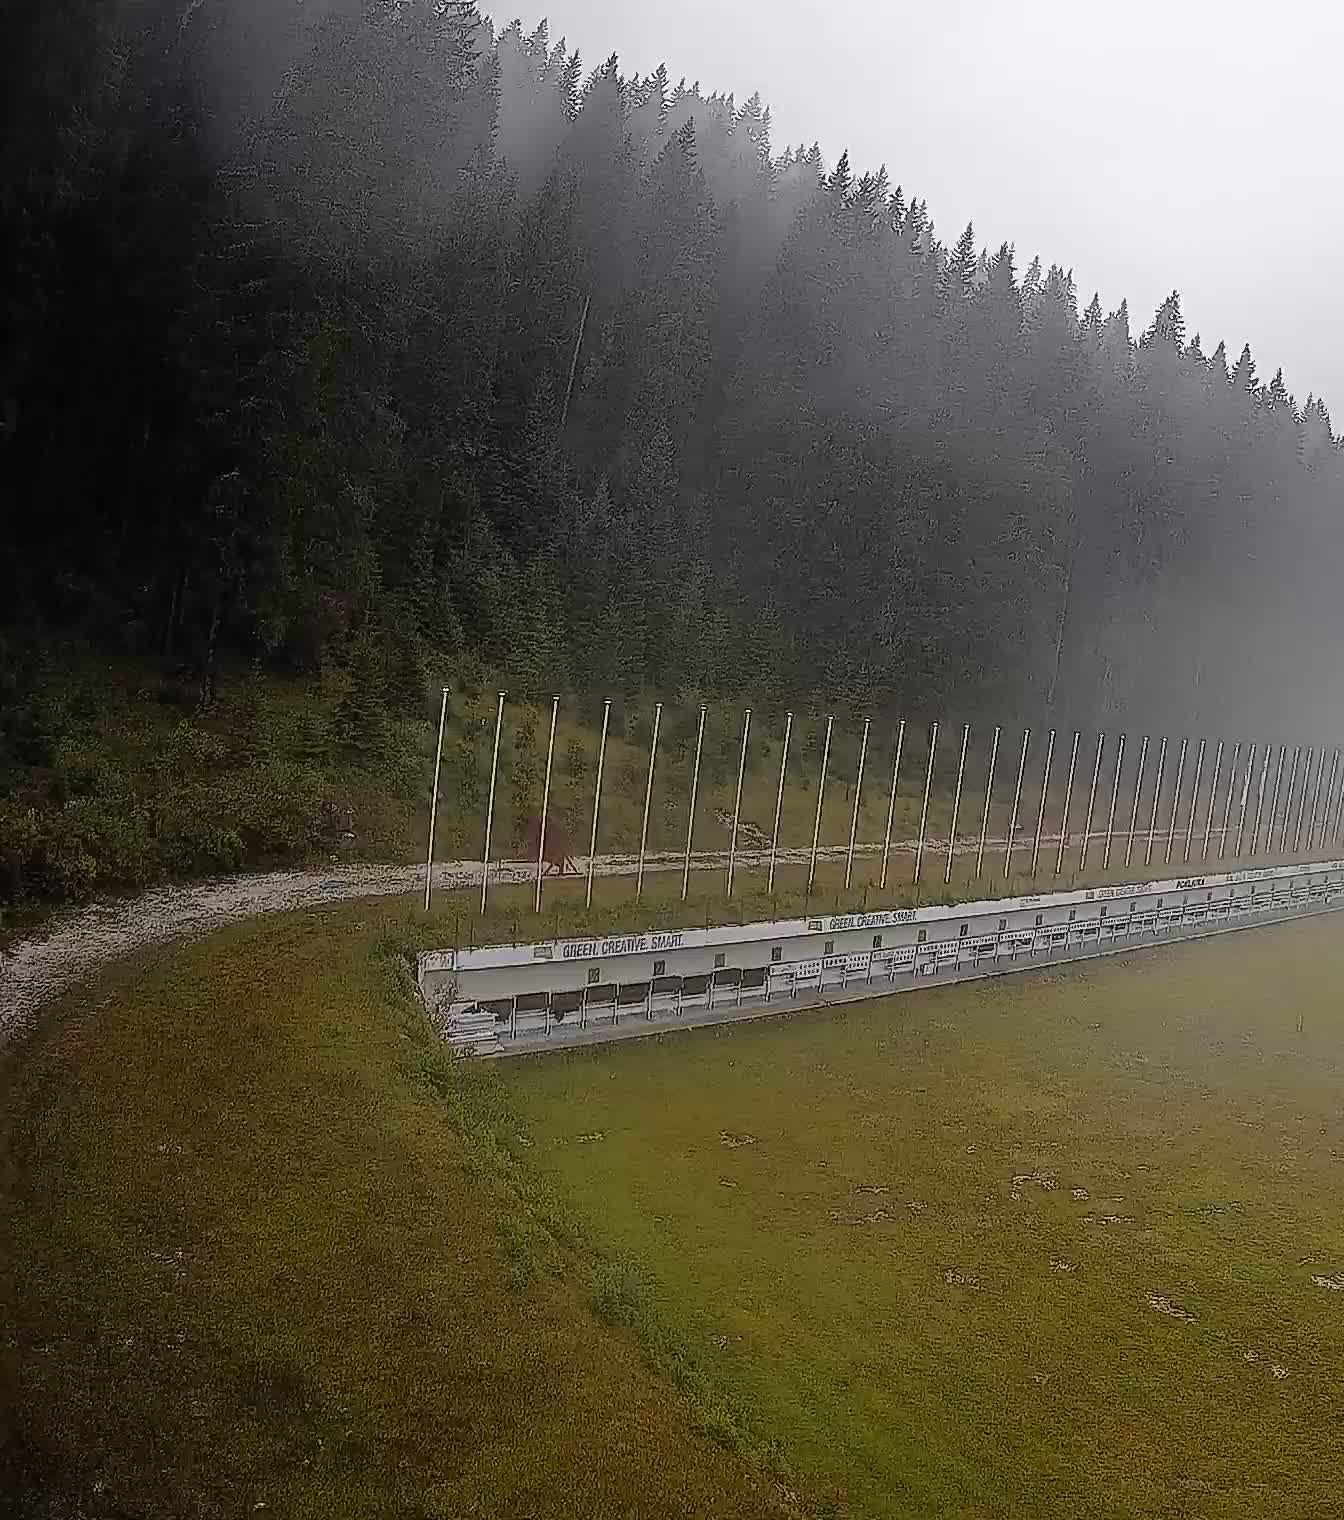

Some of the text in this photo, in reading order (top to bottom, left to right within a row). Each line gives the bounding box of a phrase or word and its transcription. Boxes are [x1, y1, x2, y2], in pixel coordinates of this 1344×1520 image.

[562, 933, 684, 959] GREEN. CREATIVE. SMART.
